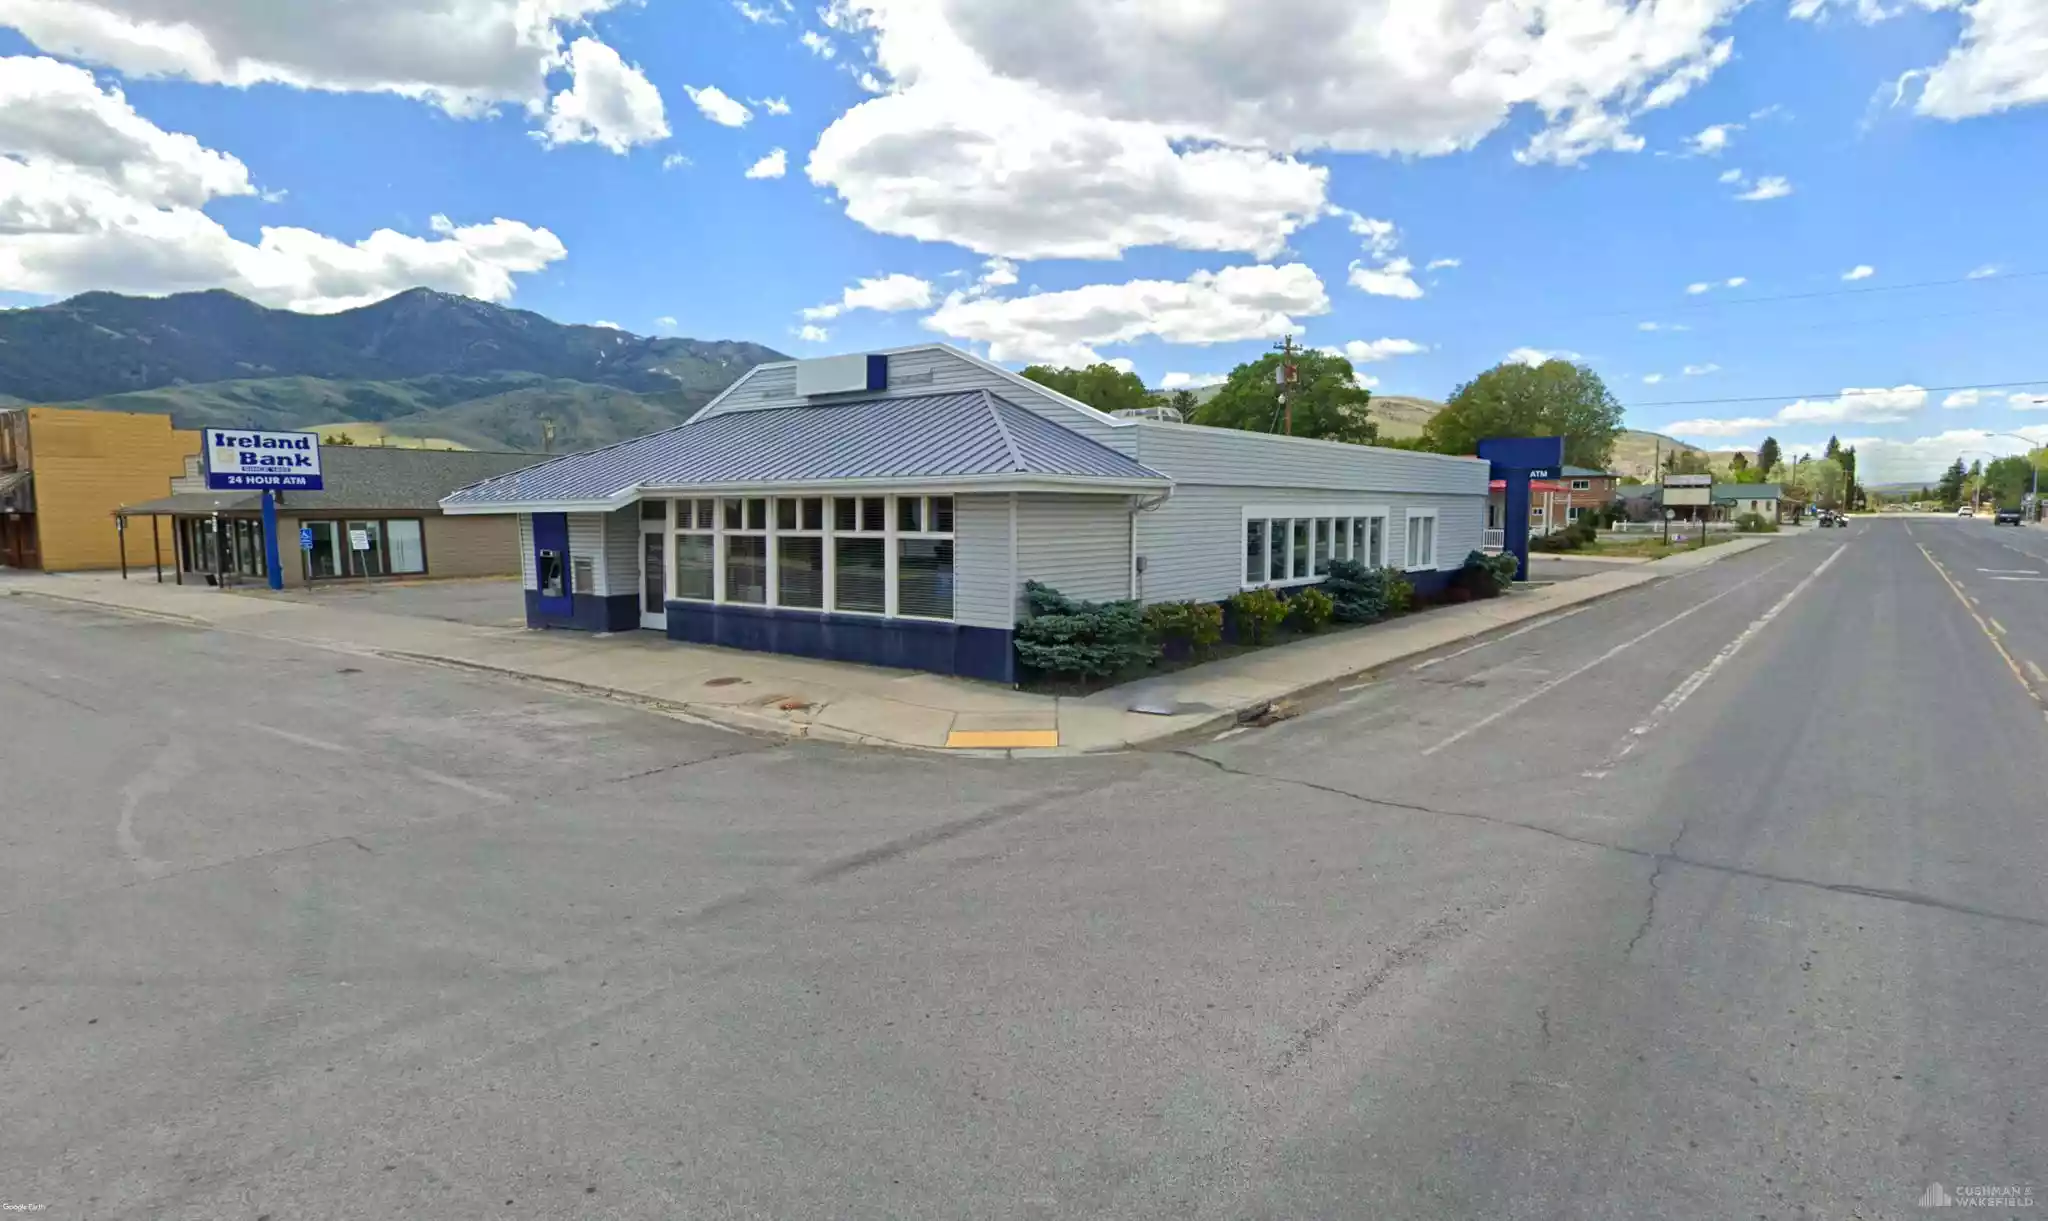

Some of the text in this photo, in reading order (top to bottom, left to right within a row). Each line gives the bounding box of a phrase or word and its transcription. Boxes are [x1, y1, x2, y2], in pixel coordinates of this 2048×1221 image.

[215, 433, 310, 450] Ireland
[239, 451, 312, 467] Bank
[1529, 470, 1548, 478] ATM
[228, 476, 307, 486] 24 HOUR ATM
